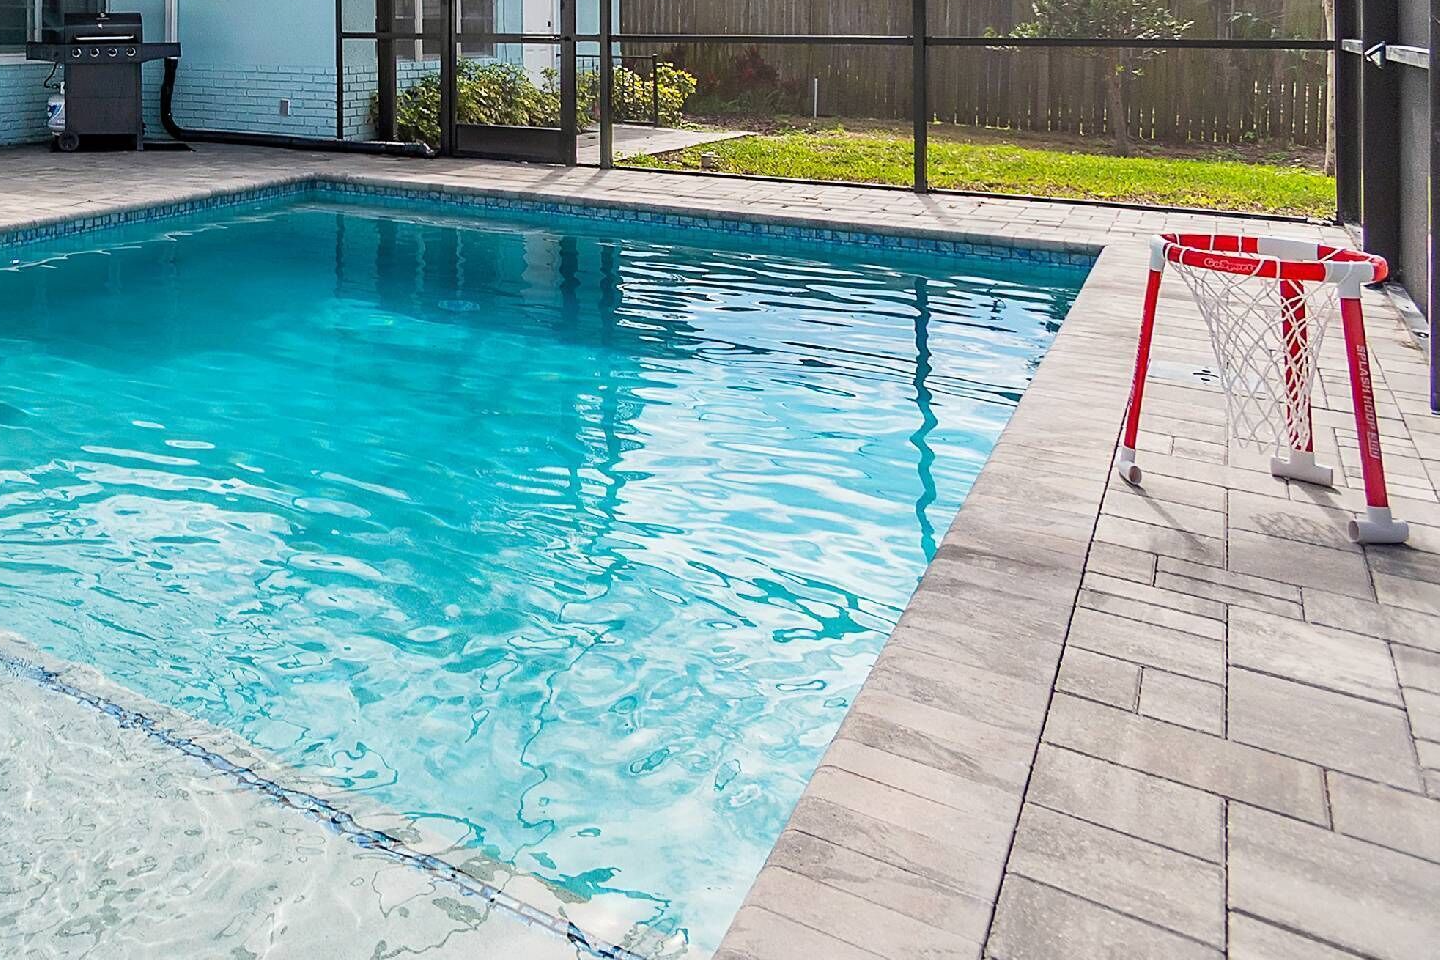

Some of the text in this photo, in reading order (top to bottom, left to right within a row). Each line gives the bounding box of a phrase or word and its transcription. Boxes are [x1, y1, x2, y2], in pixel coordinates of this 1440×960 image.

[1203, 257, 1258, 271] GoSport
[1356, 344, 1371, 393] SPLASH
[1362, 395, 1377, 433] HOOP
